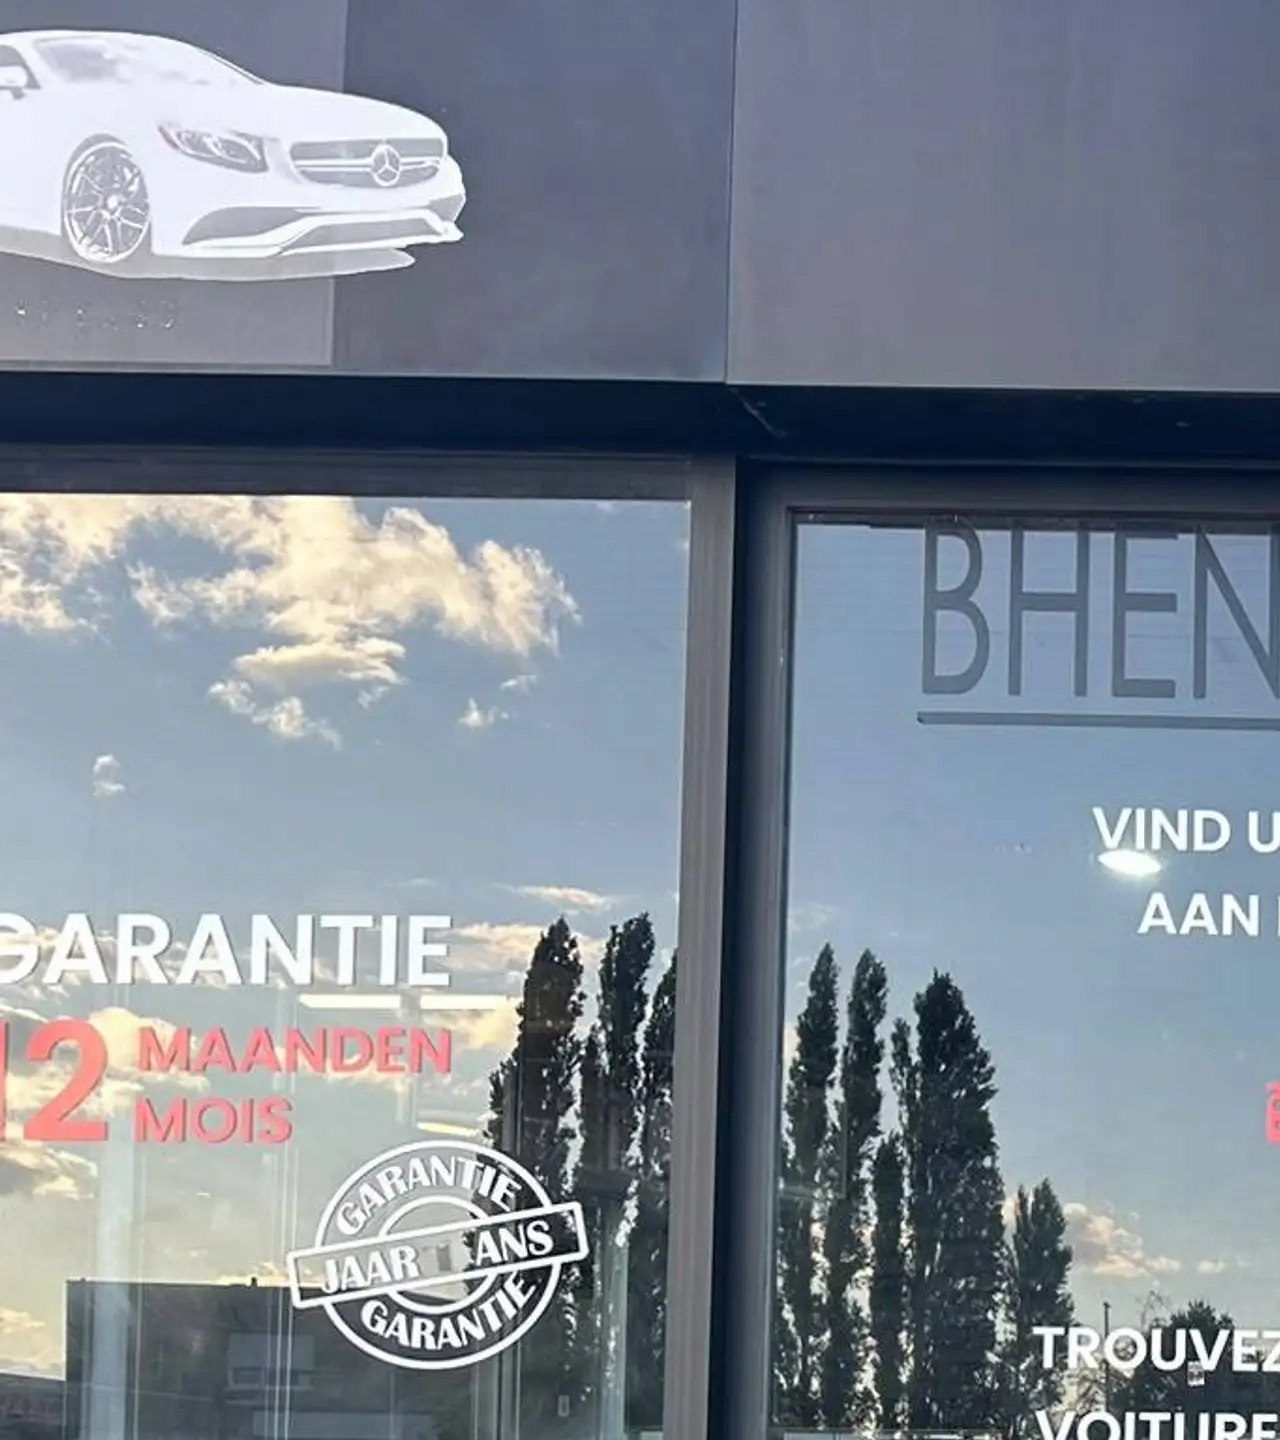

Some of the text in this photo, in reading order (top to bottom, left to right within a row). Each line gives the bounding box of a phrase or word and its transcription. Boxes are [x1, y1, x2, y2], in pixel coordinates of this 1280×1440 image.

[1093, 806, 1231, 854] VIND
[1137, 892, 1260, 938] AAN
[138, 1027, 452, 1075] MAANDEN
[133, 1097, 293, 1144] MOIS
[336, 1155, 522, 1236] GARANTIE
[320, 1245, 421, 1294] JAAR
[475, 1219, 554, 1267] ANS
[361, 1273, 536, 1351] GARANTIE
